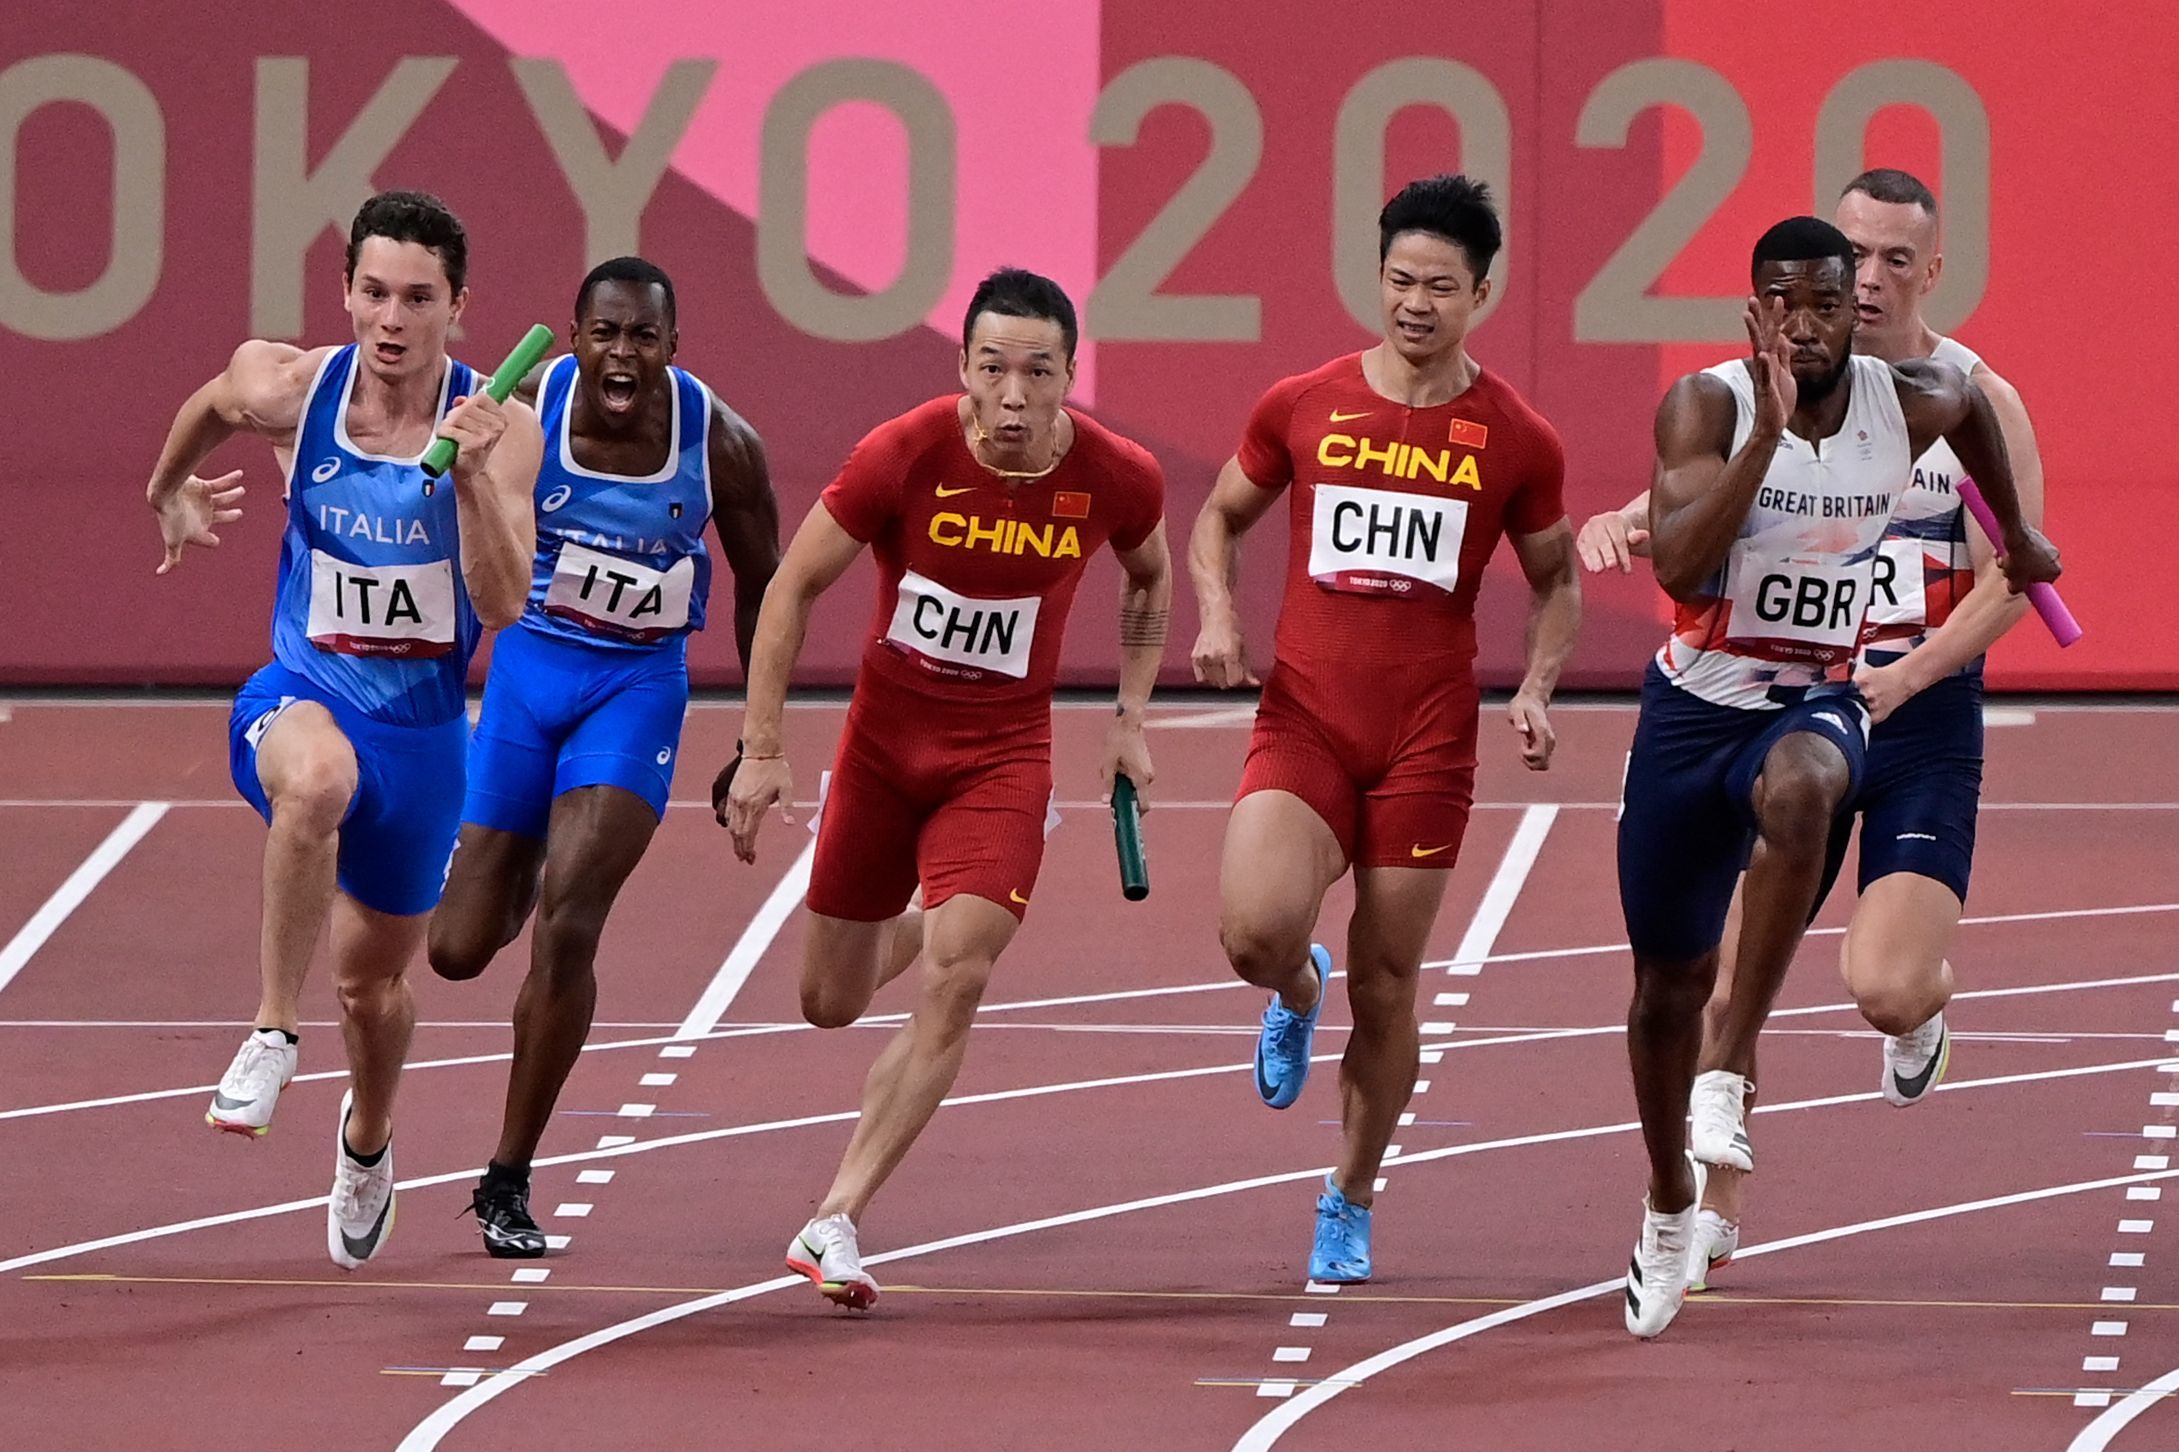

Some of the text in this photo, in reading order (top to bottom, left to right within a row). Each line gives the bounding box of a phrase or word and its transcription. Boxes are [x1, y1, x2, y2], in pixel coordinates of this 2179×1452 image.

[1086, 55, 1991, 344] 2020
[1317, 433, 1482, 490] CHINA
[320, 504, 430, 545] ITALIA
[1759, 487, 1891, 518] GREAT BRITAIN
[928, 512, 1082, 559] CHINA
[1332, 501, 1443, 562] CHN
[335, 570, 423, 626] ITA
[579, 564, 662, 619] ITA
[1755, 574, 1857, 630] GBR
[913, 594, 1019, 655] CHN
